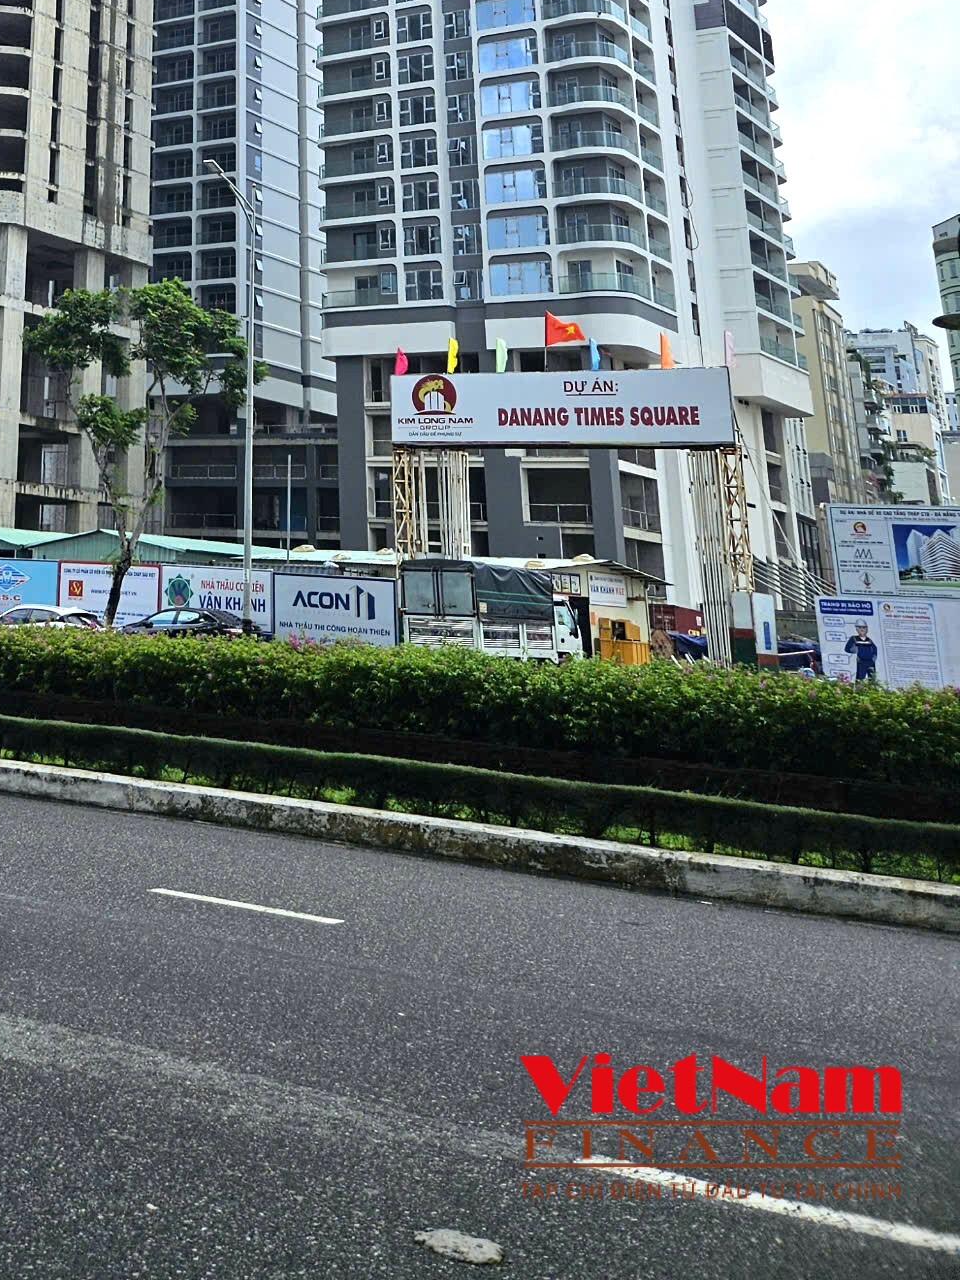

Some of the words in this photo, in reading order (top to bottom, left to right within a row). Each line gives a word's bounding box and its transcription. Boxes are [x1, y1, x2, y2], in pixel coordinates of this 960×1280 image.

[563, 380, 587, 395] DỰ
[591, 377, 619, 393] ÁN:
[497, 407, 569, 426] DANANG
[574, 406, 625, 426] TIMES
[630, 406, 700, 427] SQUARE
[201, 578, 214, 589] NHÀ
[216, 578, 234, 592] THẦU
[199, 592, 221, 610] VÂN
[225, 595, 266, 613] KHNH
[292, 590, 350, 610] ACON
[295, 621, 312, 630] THẦU
[326, 623, 346, 633] CÔNG
